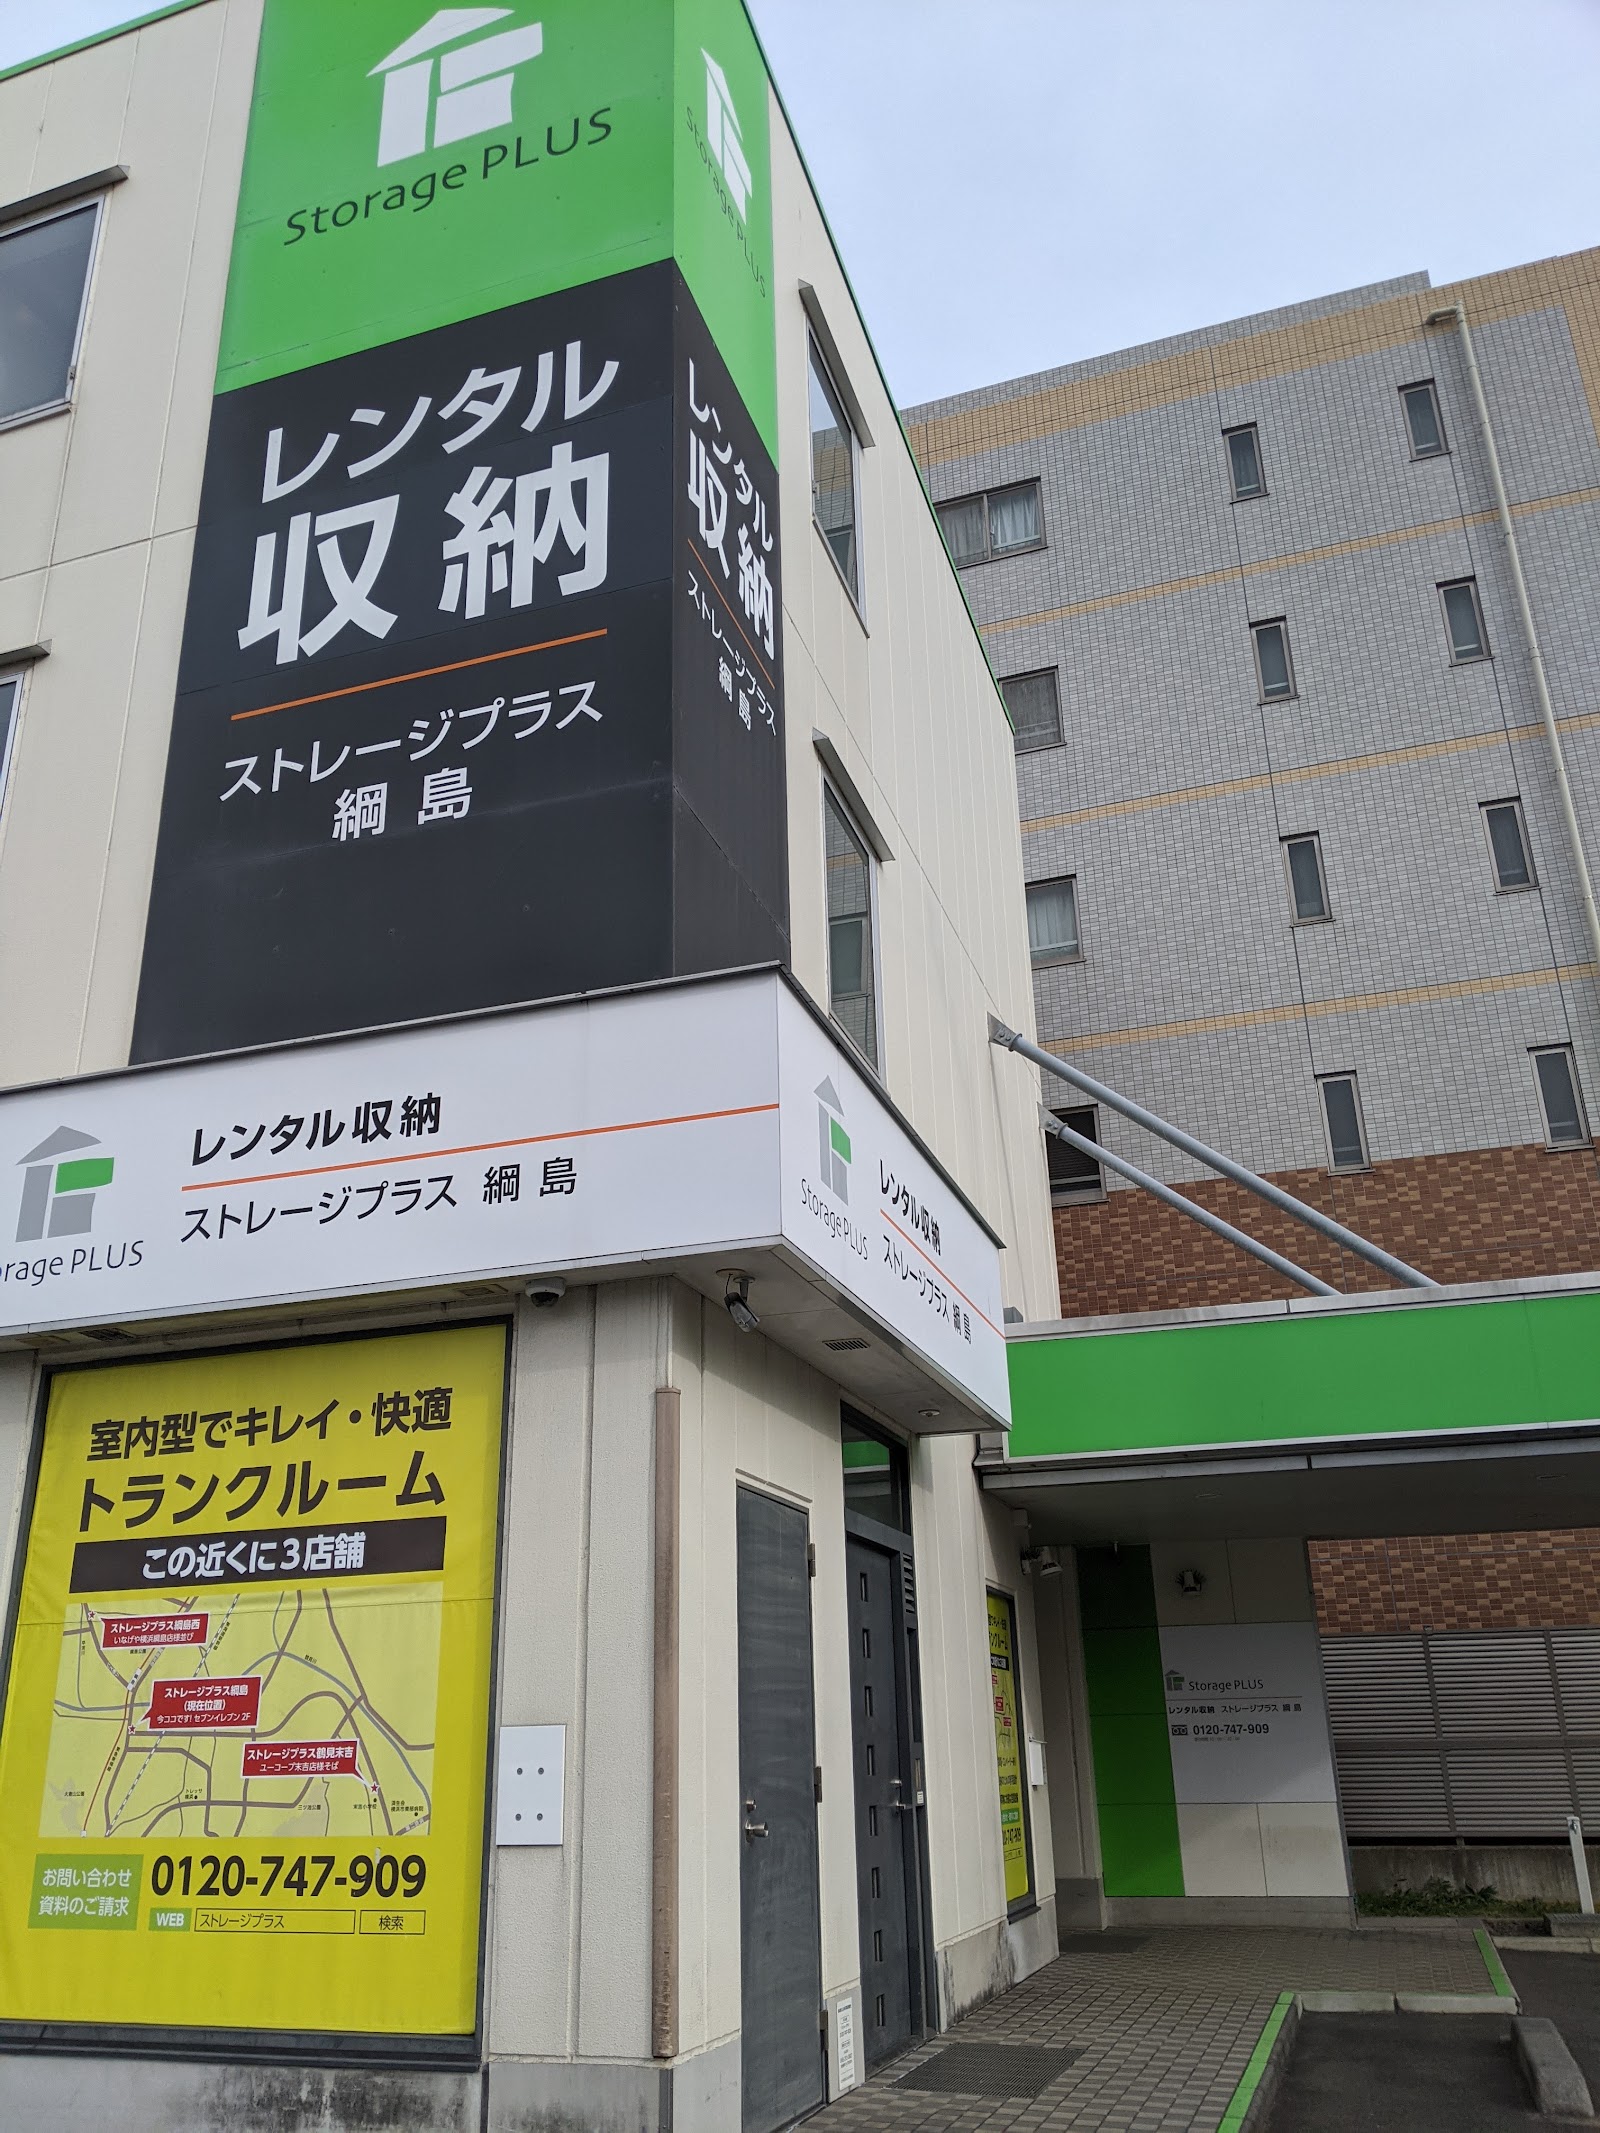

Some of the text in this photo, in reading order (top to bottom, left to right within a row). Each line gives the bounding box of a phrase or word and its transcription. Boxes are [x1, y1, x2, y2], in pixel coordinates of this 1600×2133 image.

[283, 107, 613, 246] Storage PLUS
[685, 105, 767, 298] Storage PLUS
[262, 340, 620, 504] レンタル
[689, 357, 773, 552] レンタル
[237, 441, 610, 665] 収納
[687, 429, 775, 661] 収納
[688, 569, 777, 736] ストレージプラス
[219, 680, 603, 801] ストレージプラス
[332, 767, 473, 842] 綱島
[192, 1092, 443, 1167] レンタル収納
[181, 1174, 458, 1243] ストレージプラス
[800, 1178, 869, 1261] Storage PLUS
[879, 1158, 941, 1256] レンタル収納
[0, 1240, 144, 1287] rage PLUS
[883, 1234, 950, 1323] ストレージプラス
[87, 1387, 454, 1461] 室内型でキレイ・快適
[79, 1450, 447, 1532] トランクルーム
[142, 1532, 367, 1580] この近くに3店舗
[110, 1618, 200, 1634] ストレージプラス綱島西
[164, 1684, 248, 1698] ストレージプラス綱島
[241, 1712, 251, 1721] 2F
[1169, 1705, 1215, 1715] レンタル収納
[1221, 1704, 1279, 1713] ストレージプラス
[1188, 1679, 1264, 1693] Storage PLUS
[247, 1747, 354, 1760] ストレージプラス鶴見末吉
[1193, 1724, 1270, 1735] 0120-747-909
[38, 1895, 130, 1917] 資料のご請求
[42, 1867, 132, 1888] お問い合わせ
[151, 1854, 427, 1898] 0120-747-909
[156, 1912, 185, 1928] WEB
[200, 1913, 285, 1929] ストレージプラス
[378, 1915, 404, 1931] 検索
